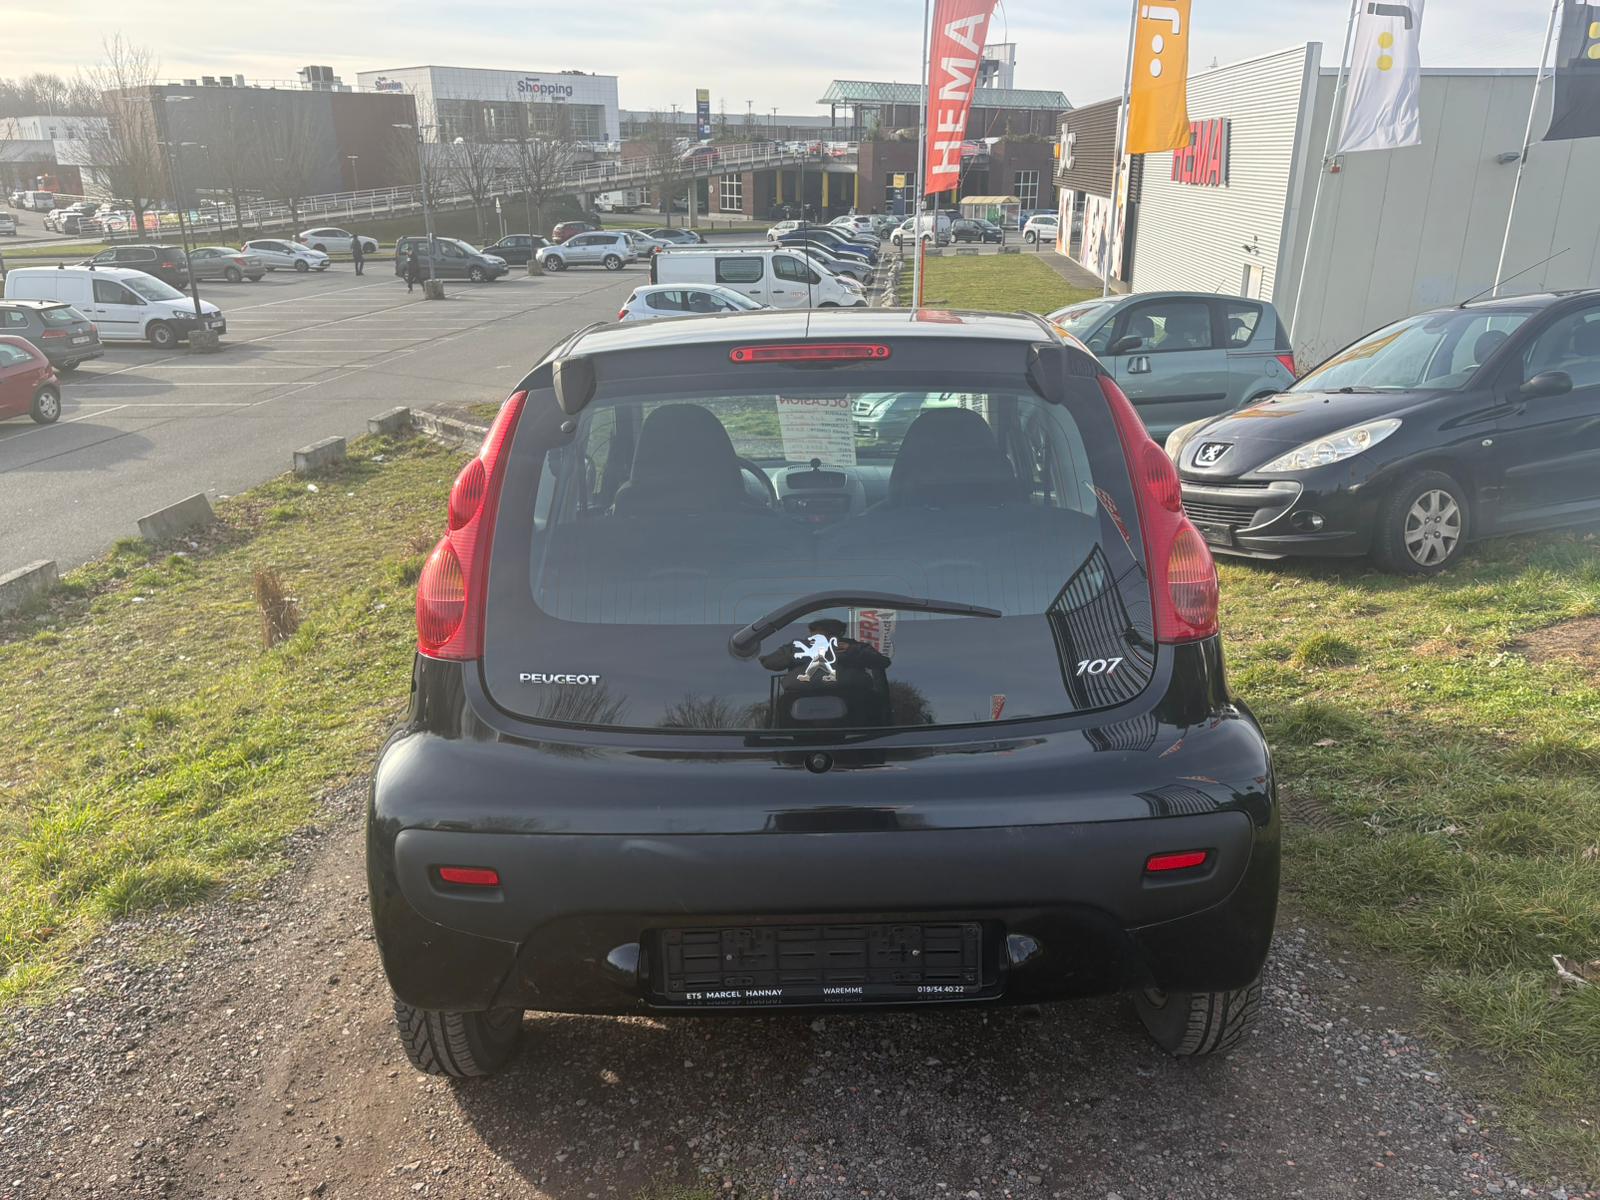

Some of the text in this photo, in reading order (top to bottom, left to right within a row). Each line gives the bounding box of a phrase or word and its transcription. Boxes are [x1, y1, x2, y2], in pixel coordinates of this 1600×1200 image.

[517, 80, 573, 97] Shopping
[932, 13, 985, 175] HEMA
[1076, 657, 1123, 676] 107
[519, 673, 600, 685] PEUGEOT
[706, 991, 742, 999] MARCEL
[745, 989, 783, 997] HANNAY
[823, 987, 863, 995] WAREMME
[917, 985, 965, 993] 019/54.40.22
